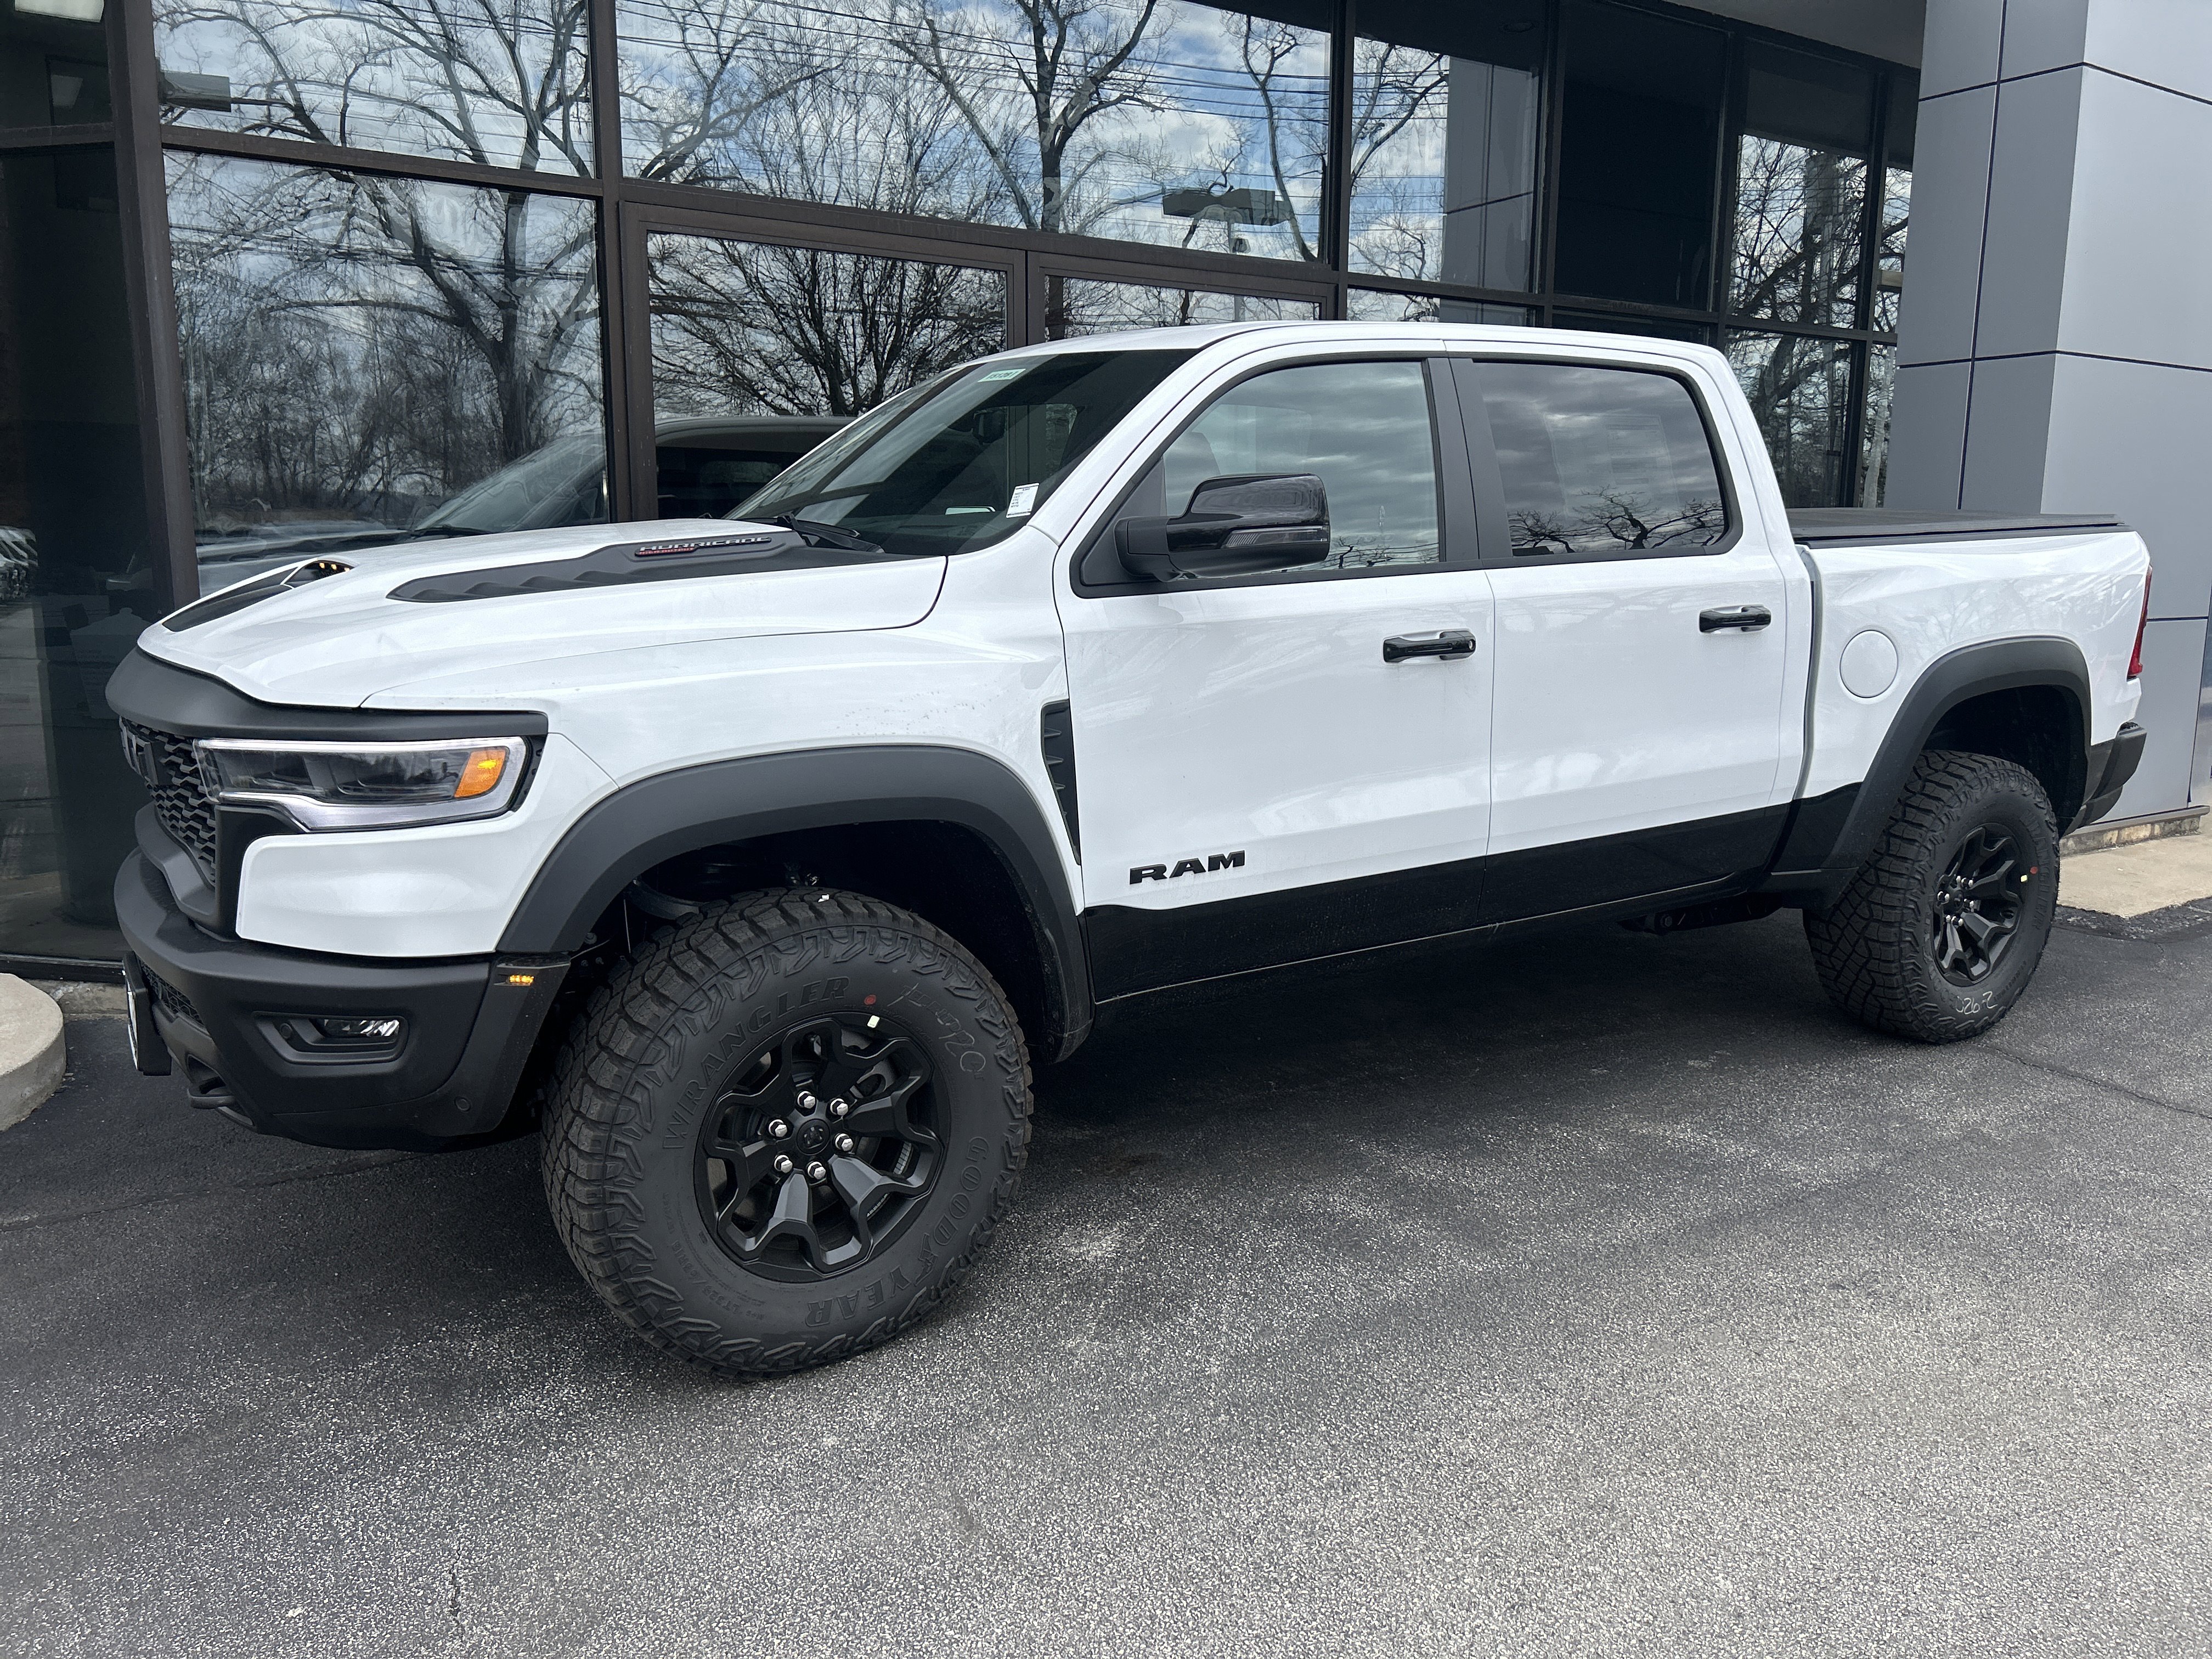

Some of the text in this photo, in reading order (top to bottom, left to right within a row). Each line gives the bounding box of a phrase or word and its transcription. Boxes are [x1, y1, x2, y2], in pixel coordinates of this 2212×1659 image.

[640, 537, 771, 551] HURRICANE
[1130, 850, 1245, 885] RAM
[663, 977, 850, 1149] WRANGLER
